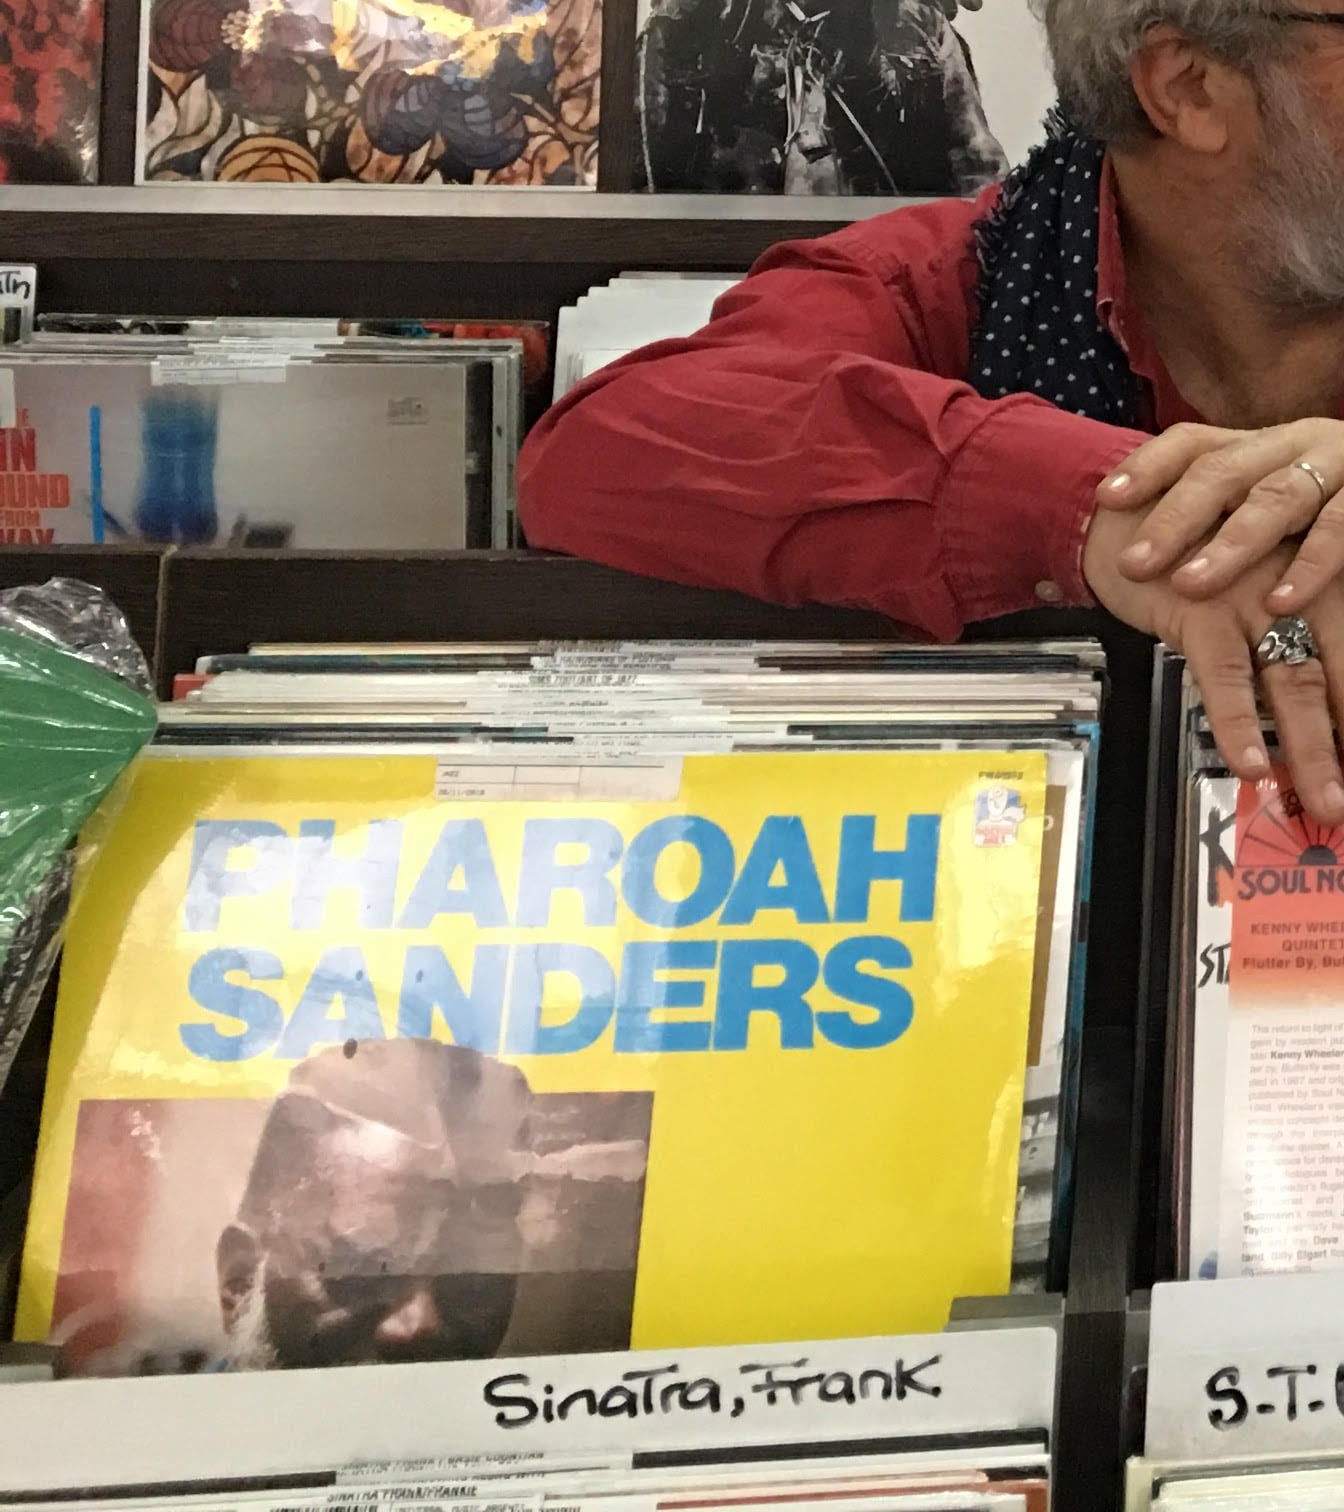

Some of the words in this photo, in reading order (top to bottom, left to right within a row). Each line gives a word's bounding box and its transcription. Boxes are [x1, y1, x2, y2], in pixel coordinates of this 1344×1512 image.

[183, 813, 942, 933] PHAROAH
[1237, 866, 1312, 901] SOUL
[1250, 922, 1302, 935] KENNY
[1242, 956, 1291, 970] Flutter
[178, 934, 916, 1063] SANDERS
[1270, 1050, 1302, 1061] Kenny
[1313, 1235, 1339, 1246] Dave
